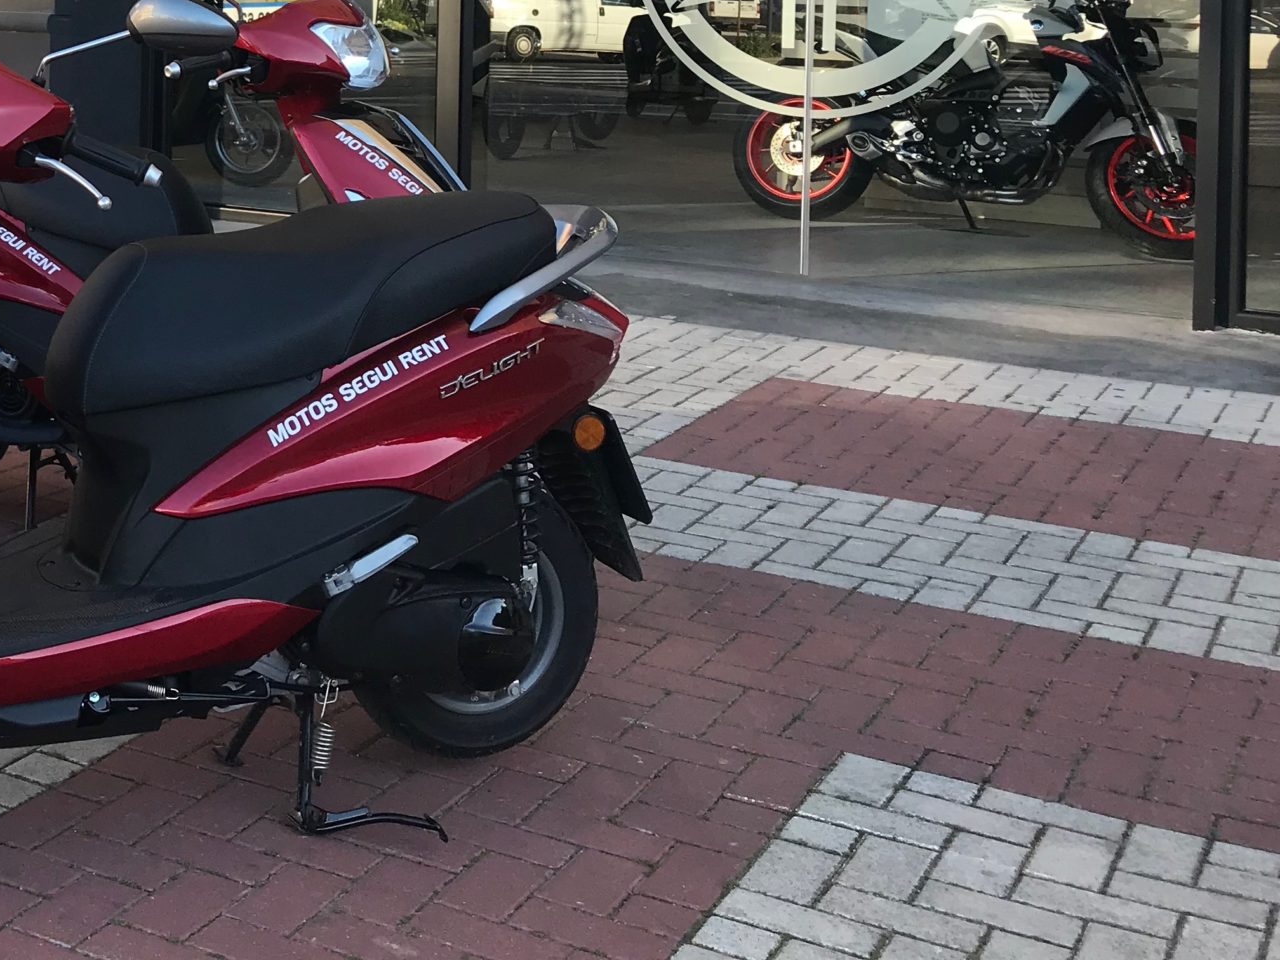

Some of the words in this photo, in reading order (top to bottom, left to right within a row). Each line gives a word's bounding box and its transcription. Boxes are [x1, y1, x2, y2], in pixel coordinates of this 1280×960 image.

[335, 131, 389, 171] MOTOS
[388, 168, 424, 195] SEG
[22, 245, 62, 276] RENT
[267, 392, 338, 447] MOTOS
[340, 359, 399, 403] SEGUI
[401, 334, 450, 371] RENT
